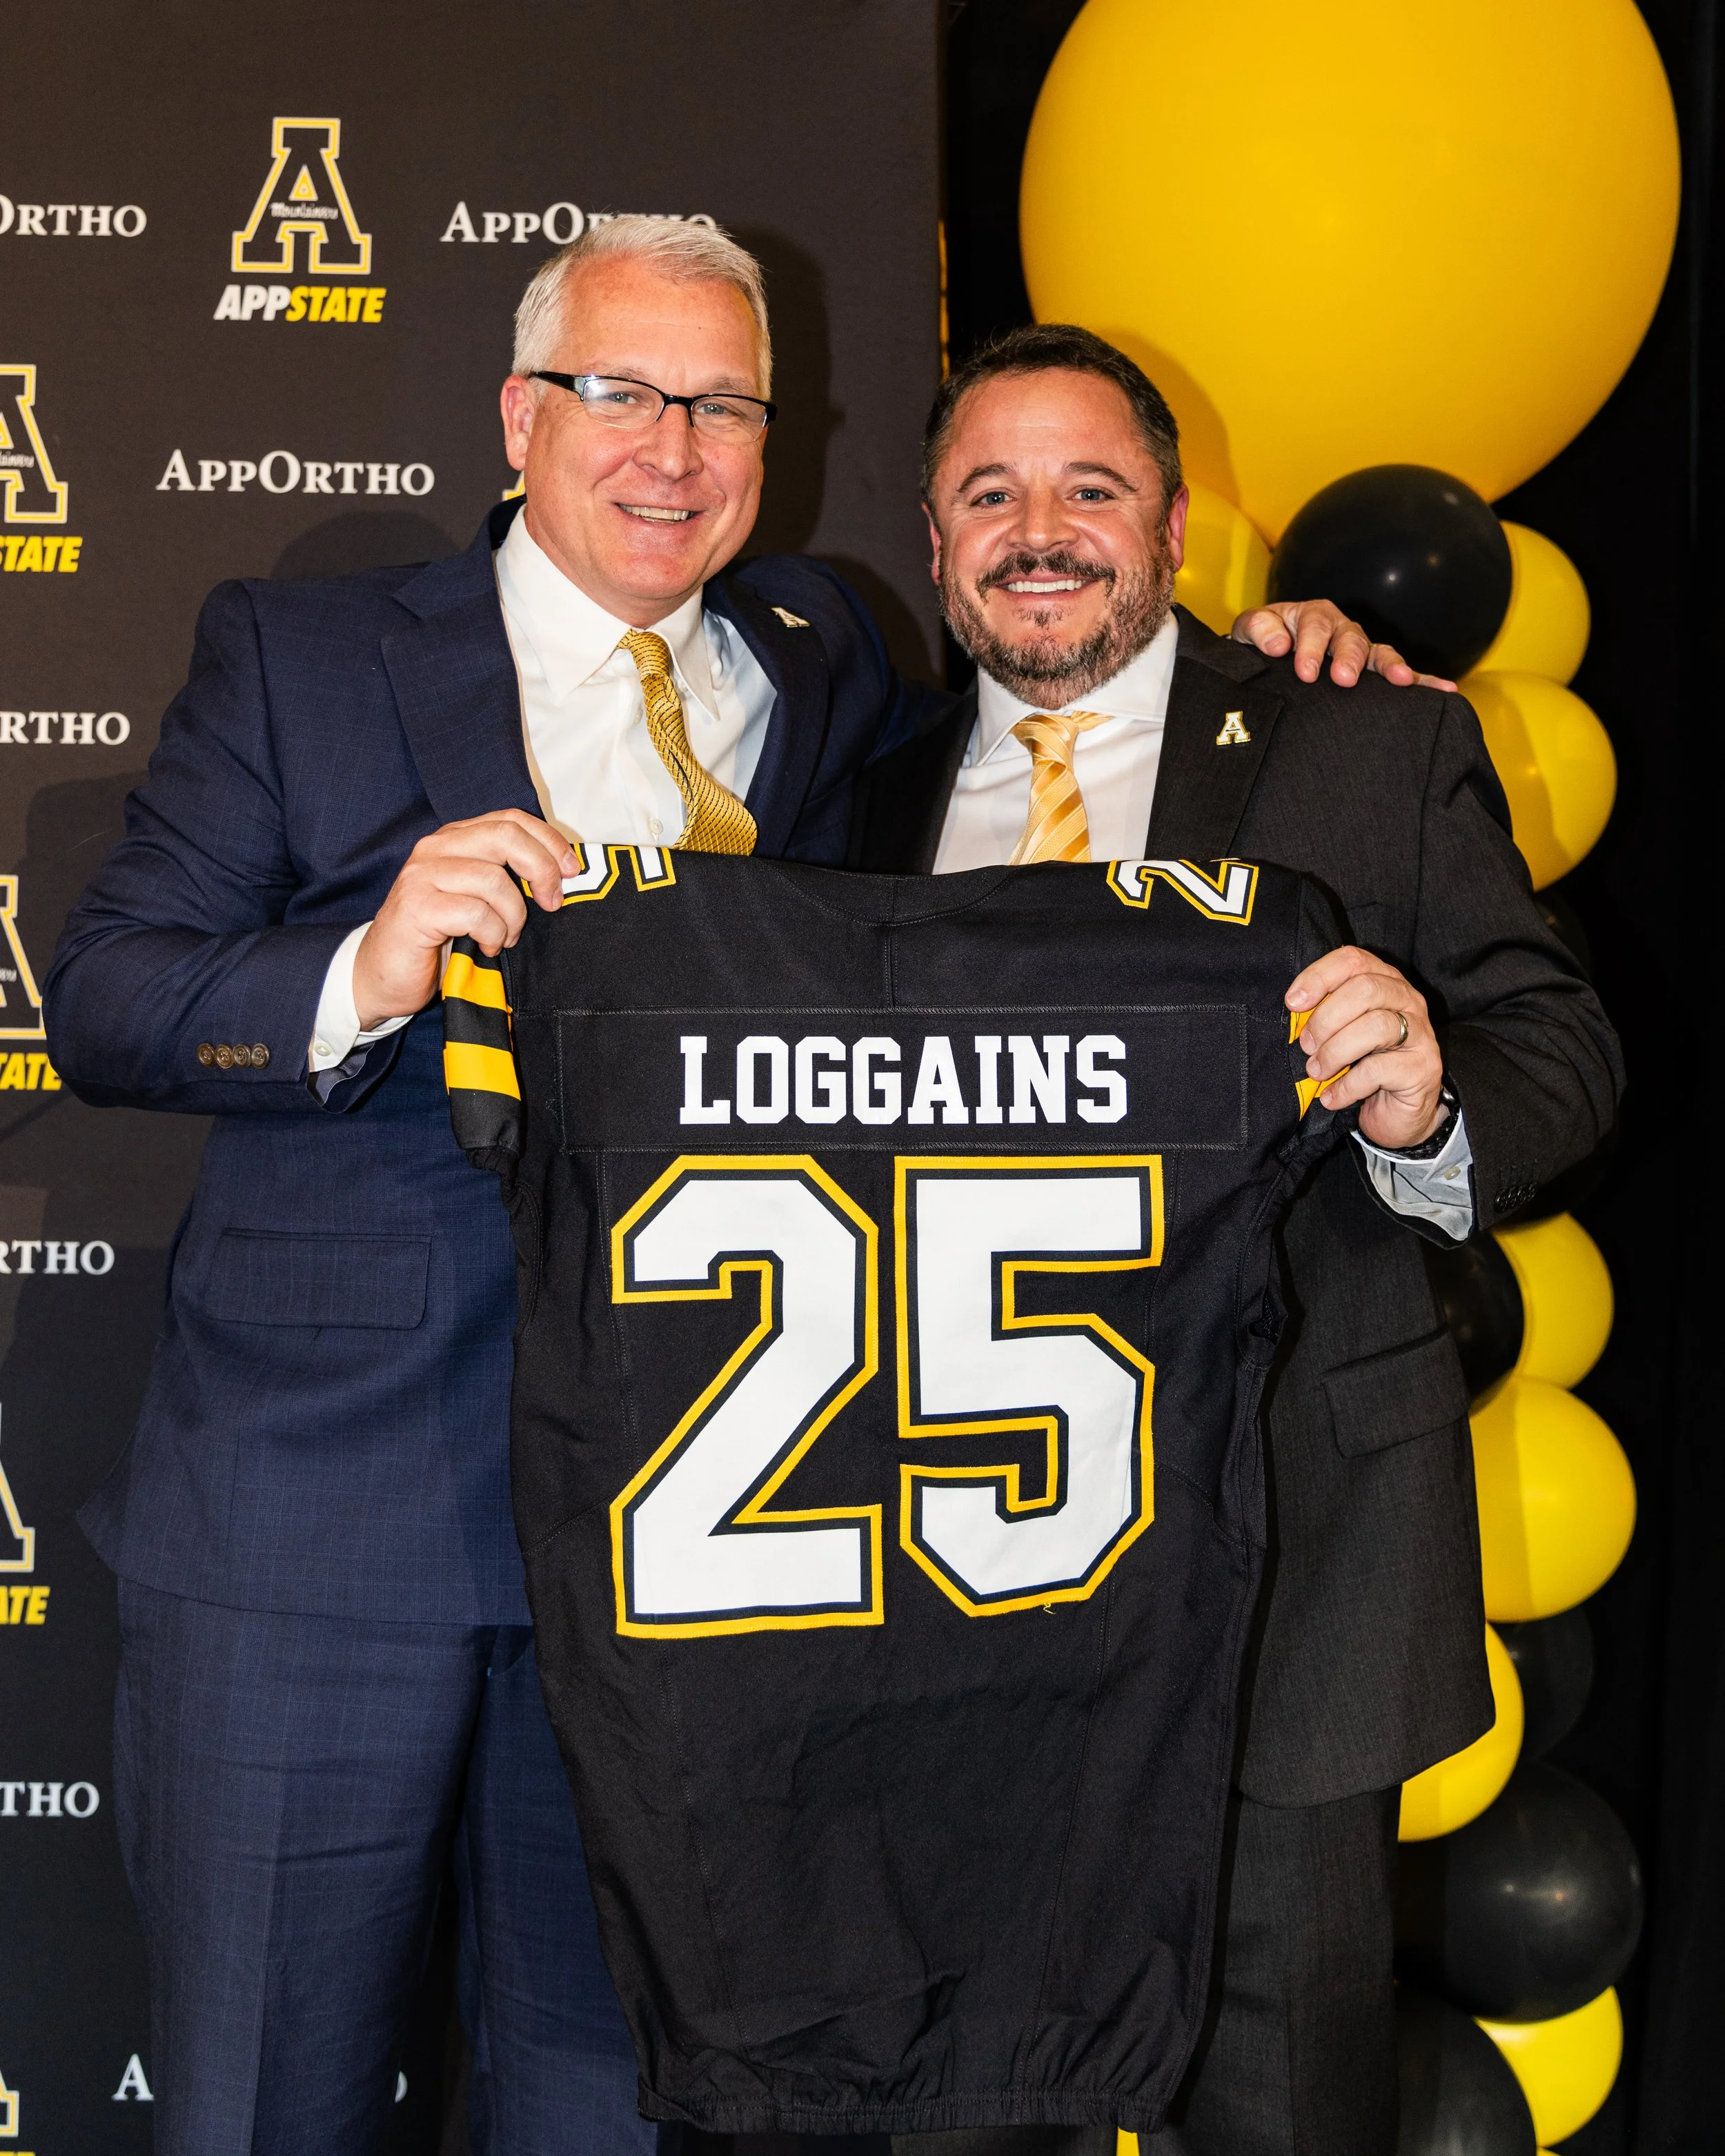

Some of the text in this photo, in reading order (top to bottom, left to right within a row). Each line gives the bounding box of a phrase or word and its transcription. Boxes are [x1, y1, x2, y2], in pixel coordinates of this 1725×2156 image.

[214, 284, 386, 322] APPSTATE
[0, 536, 83, 572] TATE
[1216, 711, 1251, 745] A
[679, 1035, 1127, 1125] LOGGAINS
[610, 1154, 1167, 1639] 25
